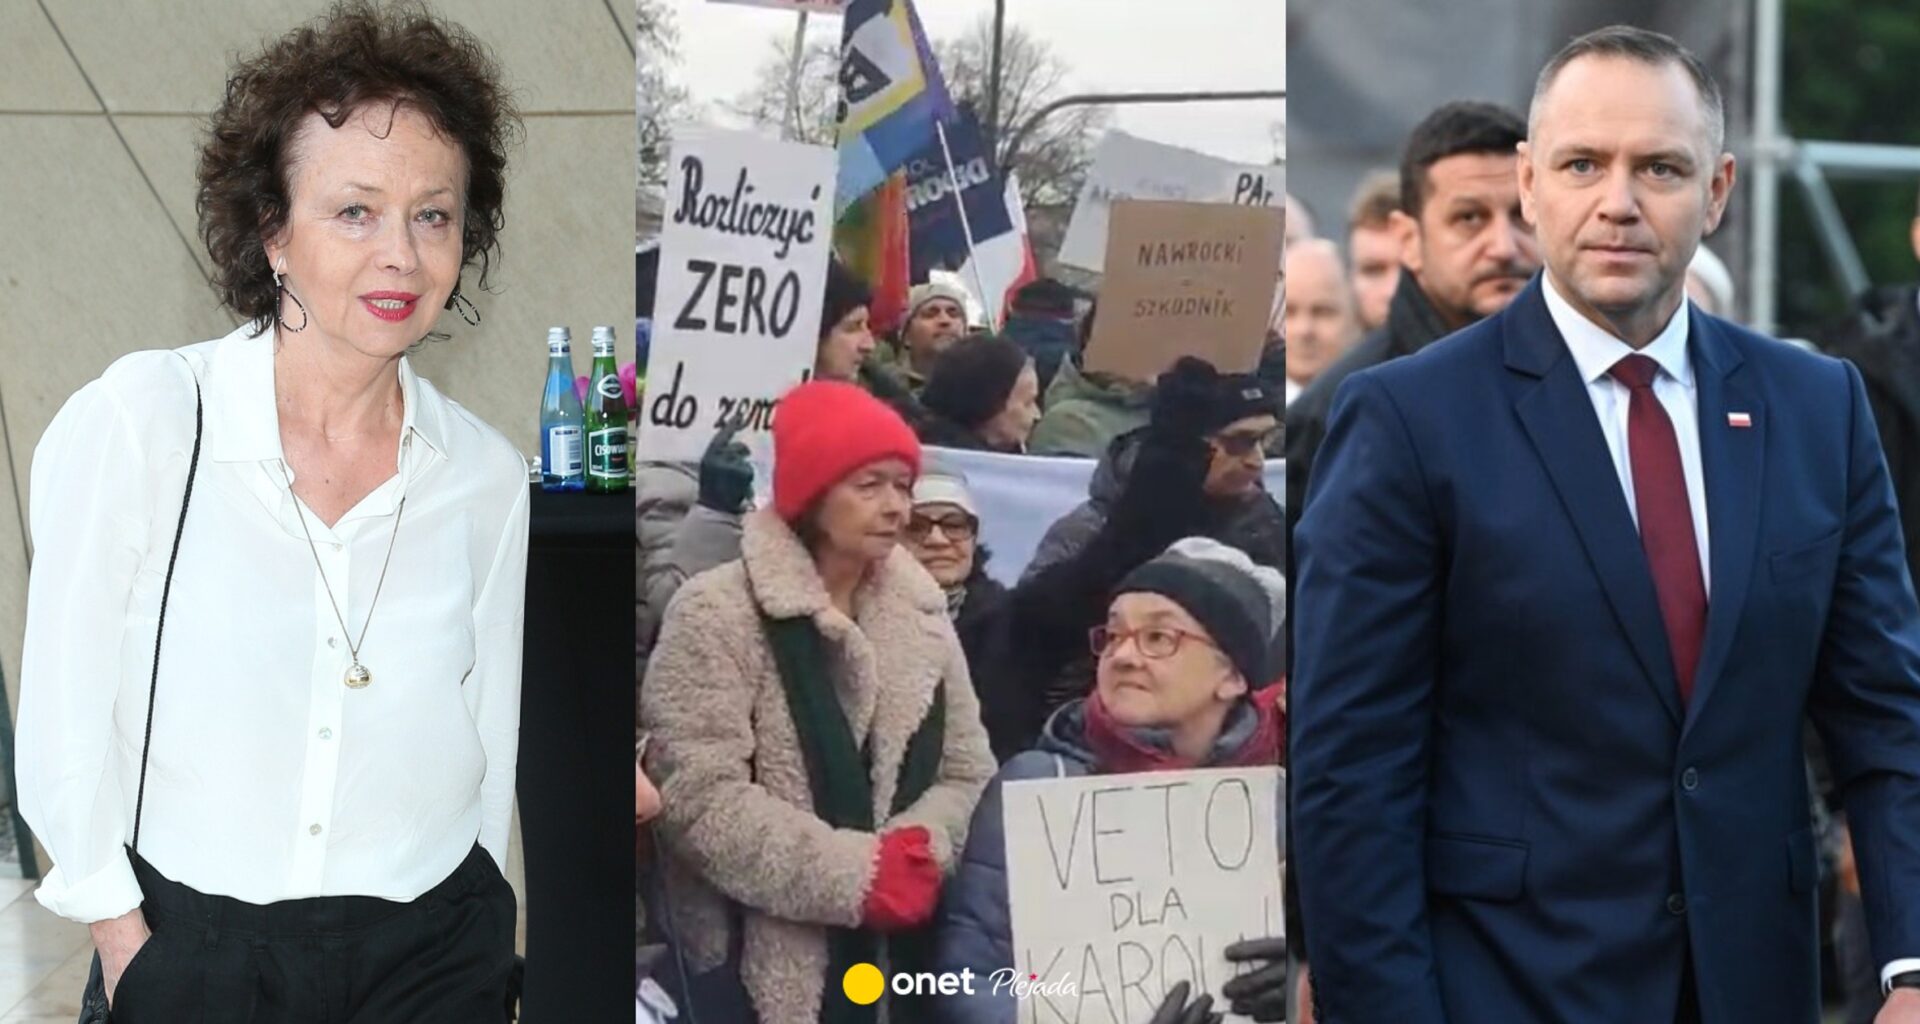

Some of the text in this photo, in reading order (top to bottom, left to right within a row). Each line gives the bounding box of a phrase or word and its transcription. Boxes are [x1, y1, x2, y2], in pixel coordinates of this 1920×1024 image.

[673, 155, 821, 260] Rozliczyć
[673, 259, 801, 339] ZERO
[651, 361, 697, 429] do
[1037, 777, 1254, 890] VETO
[1110, 886, 1188, 933] DLA
